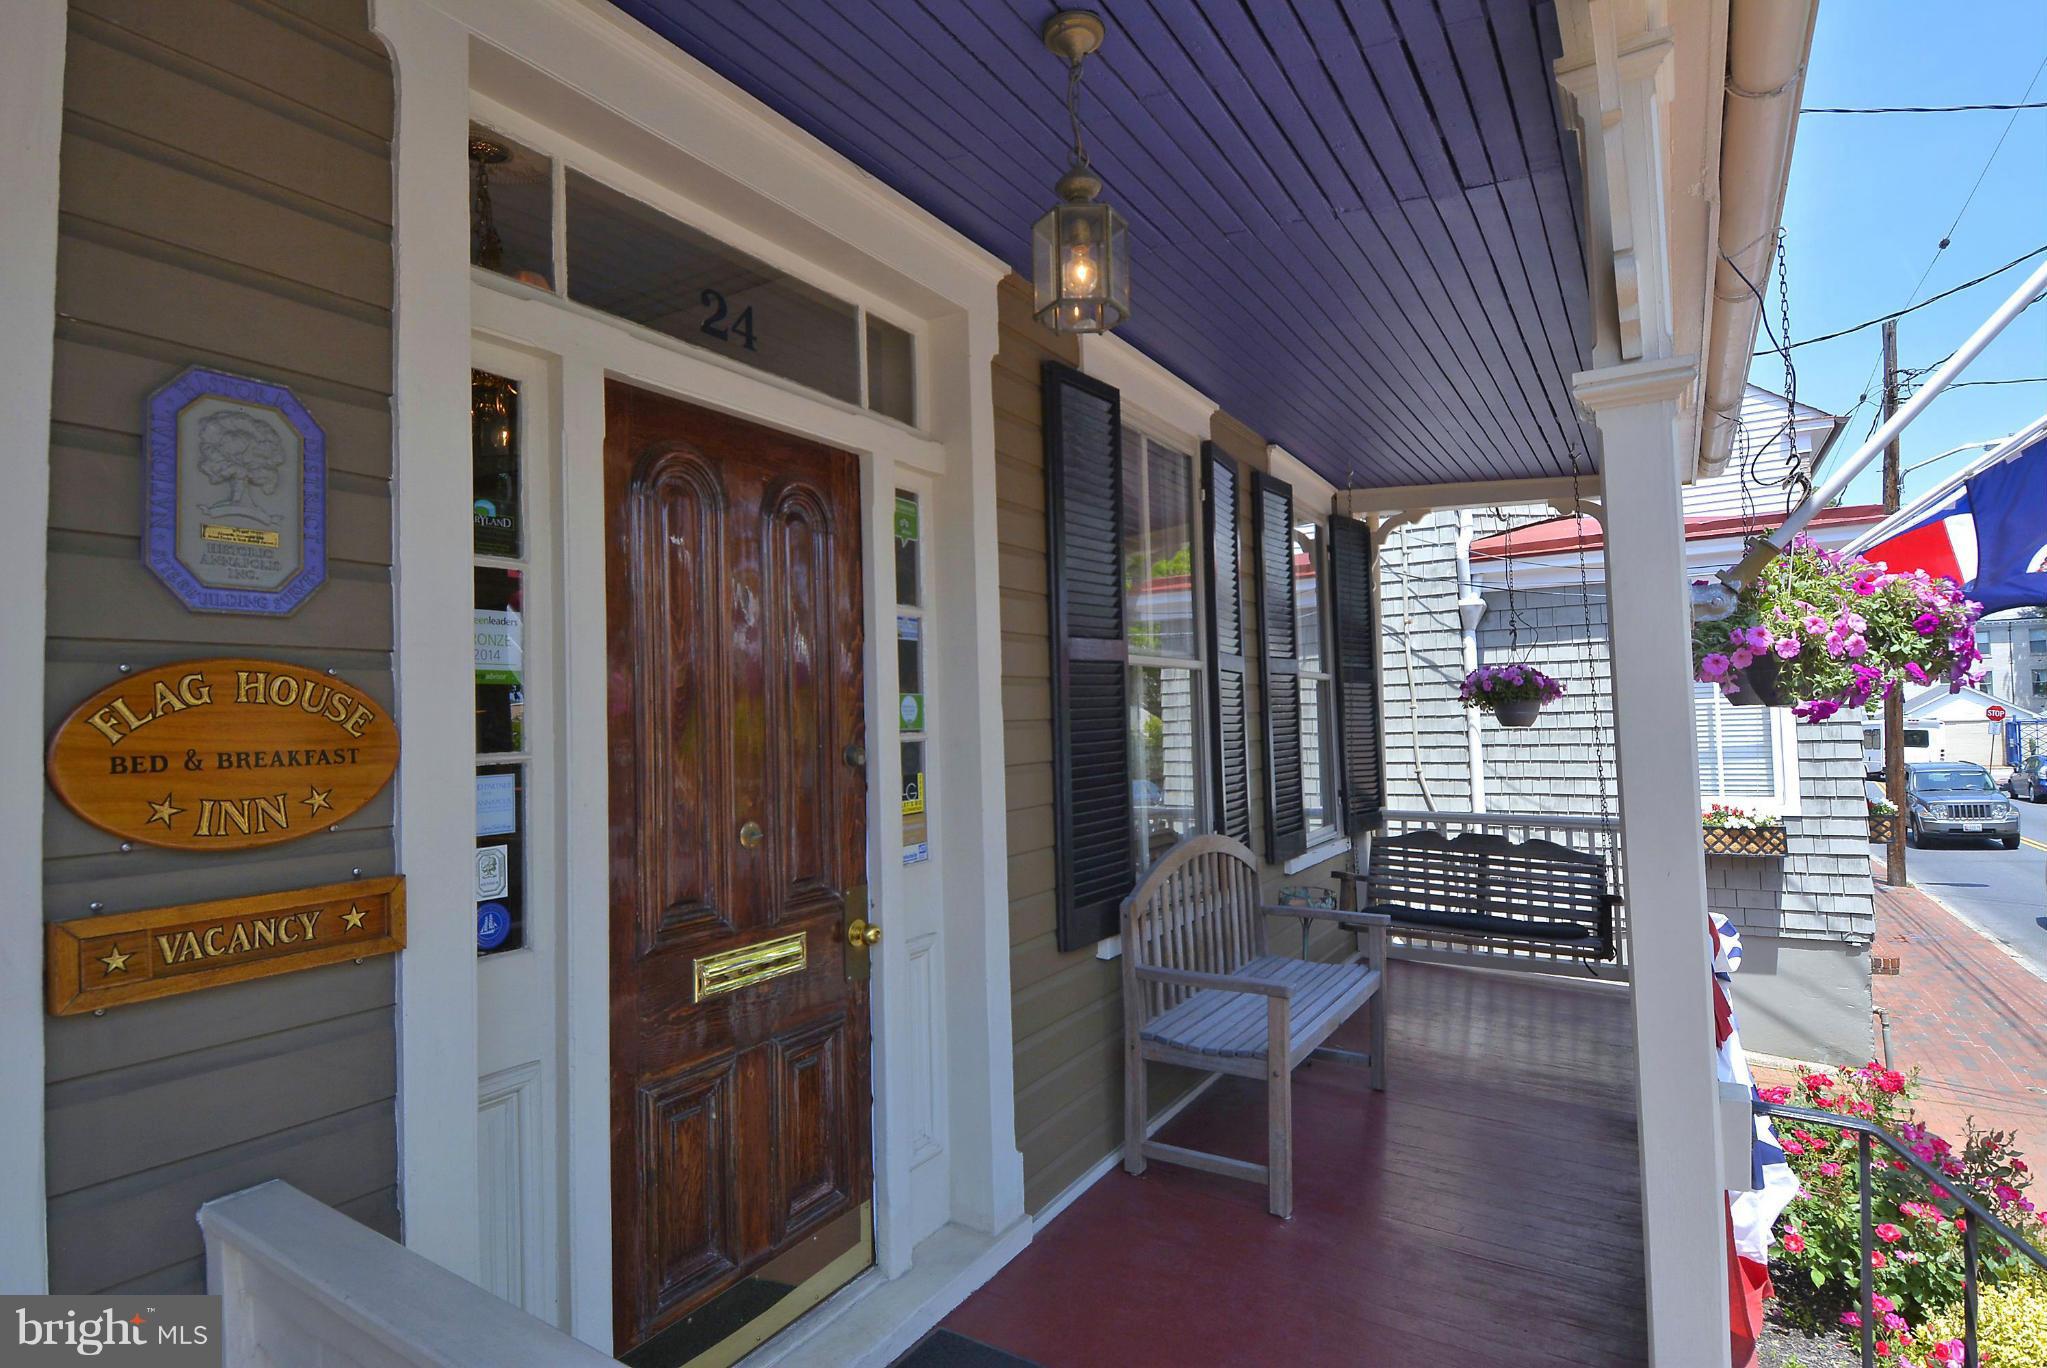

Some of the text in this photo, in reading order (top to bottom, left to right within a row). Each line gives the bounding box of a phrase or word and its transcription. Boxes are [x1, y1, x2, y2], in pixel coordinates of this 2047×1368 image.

[701, 288, 758, 352] 24
[304, 437, 321, 545] DISTRICT
[474, 513, 512, 528] RYLAND
[474, 616, 519, 626] eenleaders
[474, 649, 500, 661] 2014
[85, 670, 375, 747] FLAG HOUSE
[109, 747, 360, 775] BED & BREAKFAST
[193, 793, 290, 837] INN
[157, 909, 323, 965] VACANCY
